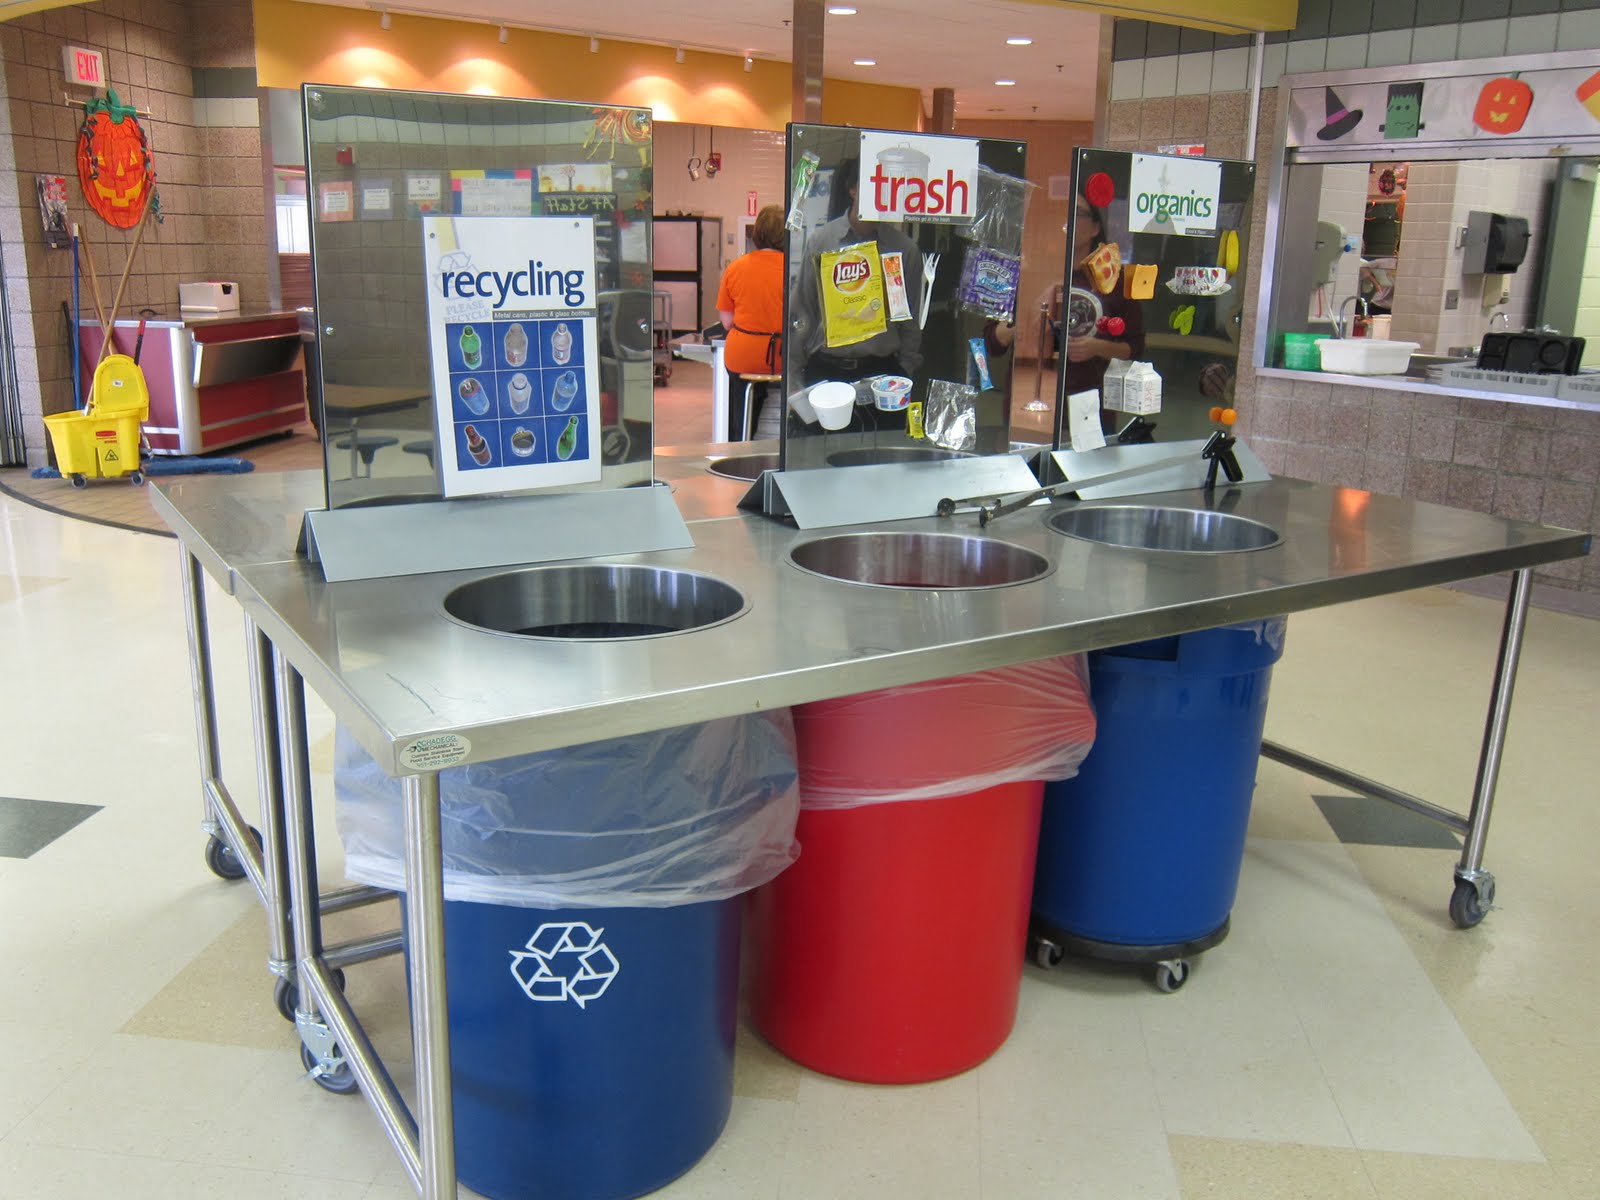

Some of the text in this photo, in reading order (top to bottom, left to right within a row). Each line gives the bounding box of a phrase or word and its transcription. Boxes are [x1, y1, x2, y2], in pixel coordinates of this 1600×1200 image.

[76, 51, 99, 82] EXIT
[870, 163, 969, 215] trash
[1136, 189, 1212, 224] organics
[441, 259, 586, 309] recycling
[835, 261, 867, 285] Lay's
[446, 300, 485, 316] PLEASE
[843, 294, 867, 305] Classic
[529, 311, 549, 319] plastic
[555, 311, 570, 319] glass
